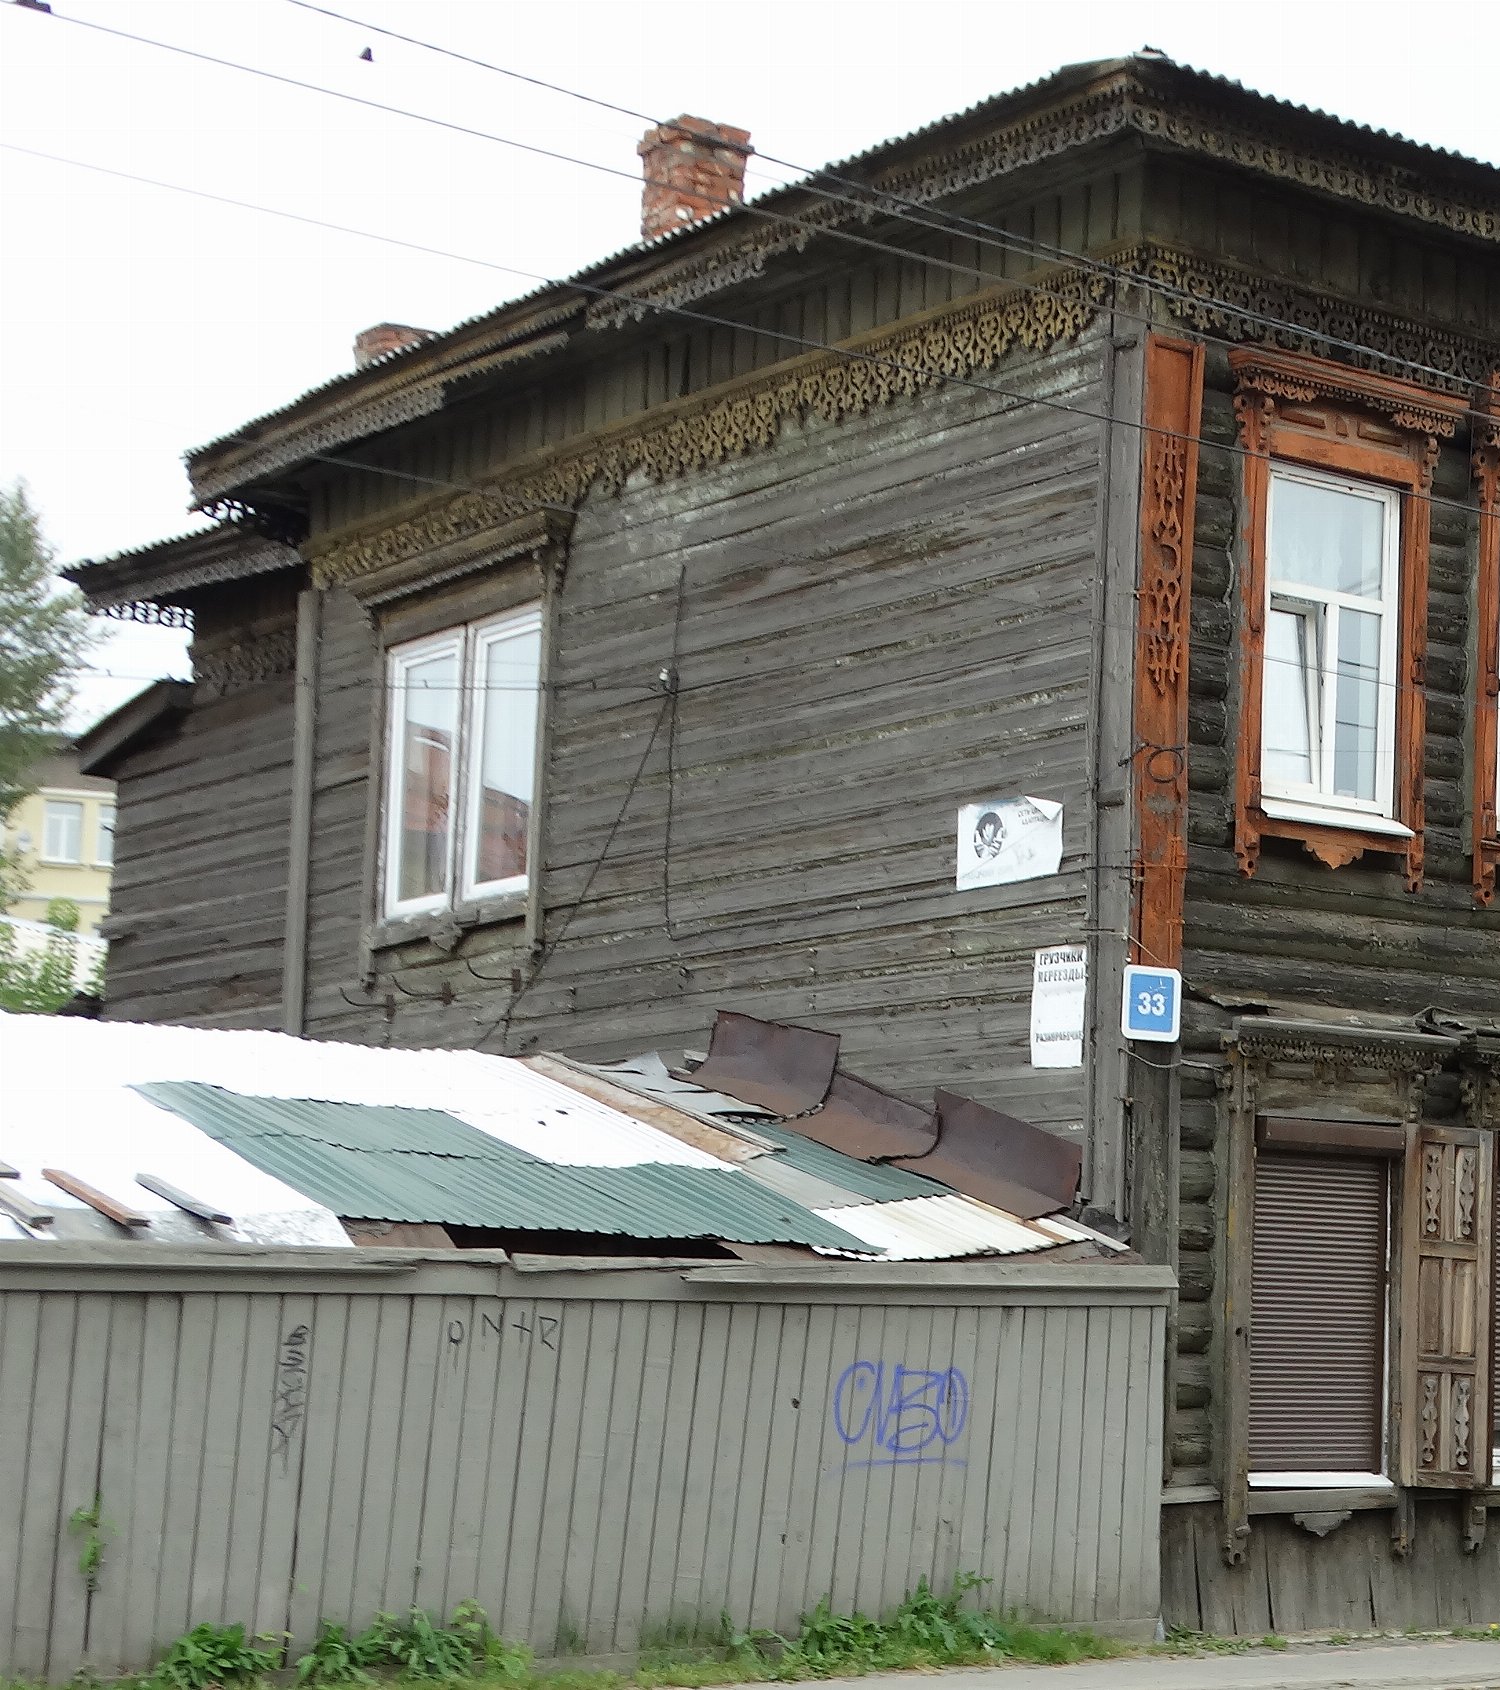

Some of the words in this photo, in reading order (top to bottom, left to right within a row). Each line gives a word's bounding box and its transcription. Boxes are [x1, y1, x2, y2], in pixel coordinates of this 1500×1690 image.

[1039, 949, 1084, 966] ГРУЗЧИКИ
[1037, 967, 1085, 983] ПЕРЕЕЗДЫ
[1137, 991, 1166, 1017] 33
